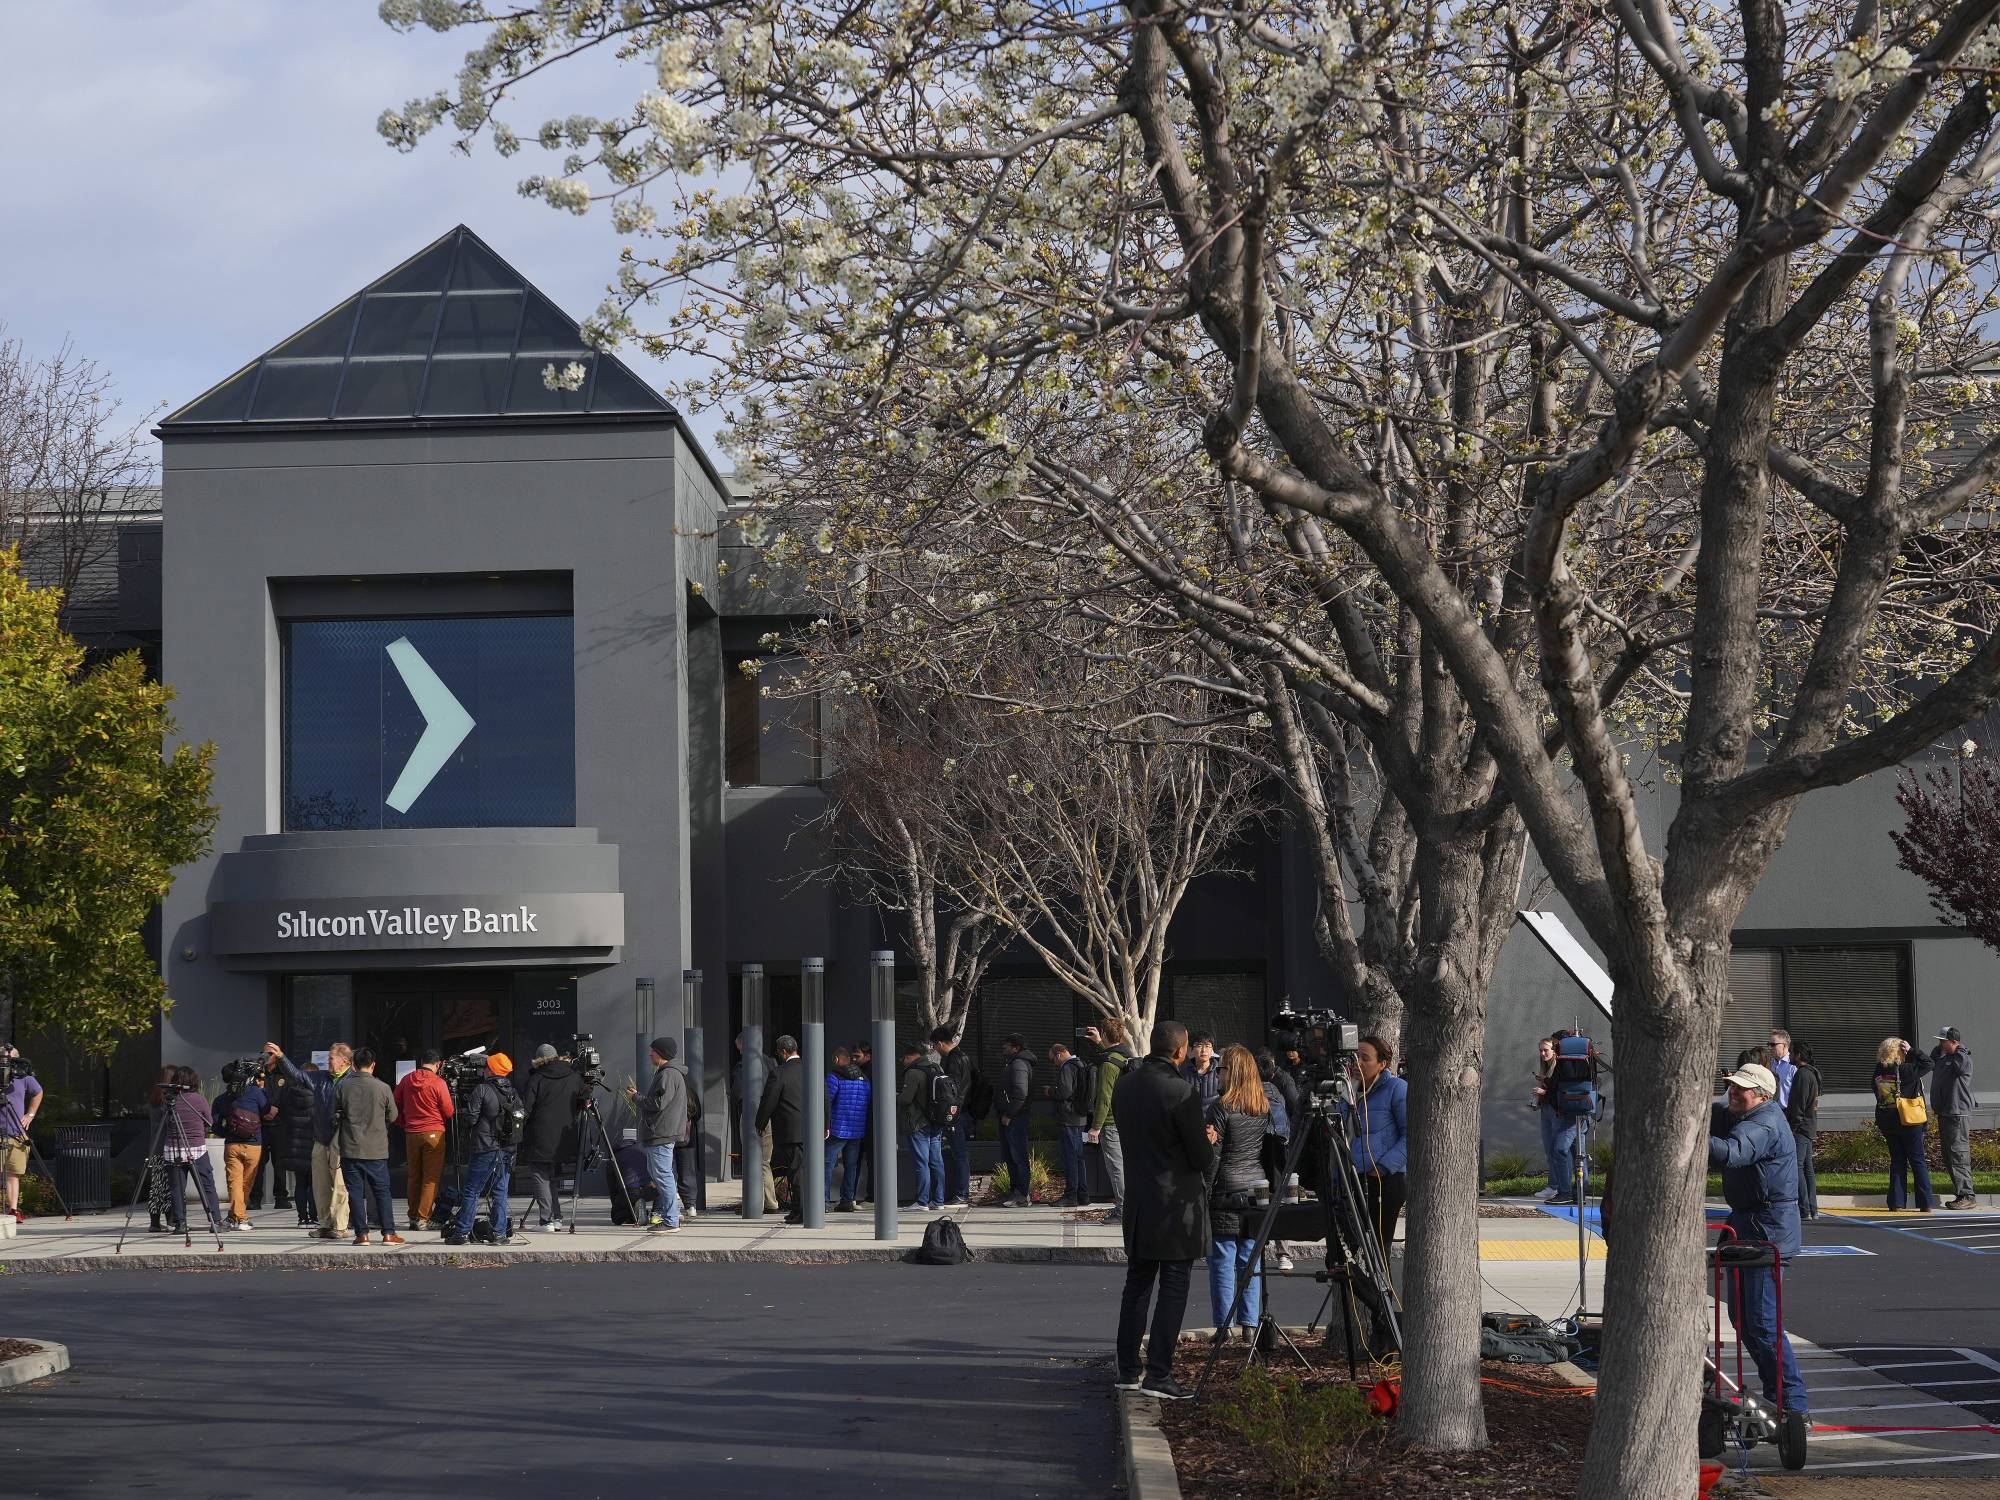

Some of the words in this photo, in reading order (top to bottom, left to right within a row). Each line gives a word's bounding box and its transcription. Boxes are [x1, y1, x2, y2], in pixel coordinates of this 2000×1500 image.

[277, 910, 366, 938] Silicon
[367, 907, 459, 940] Valley
[462, 905, 538, 933] Bank
[536, 999, 561, 1009] 3003
